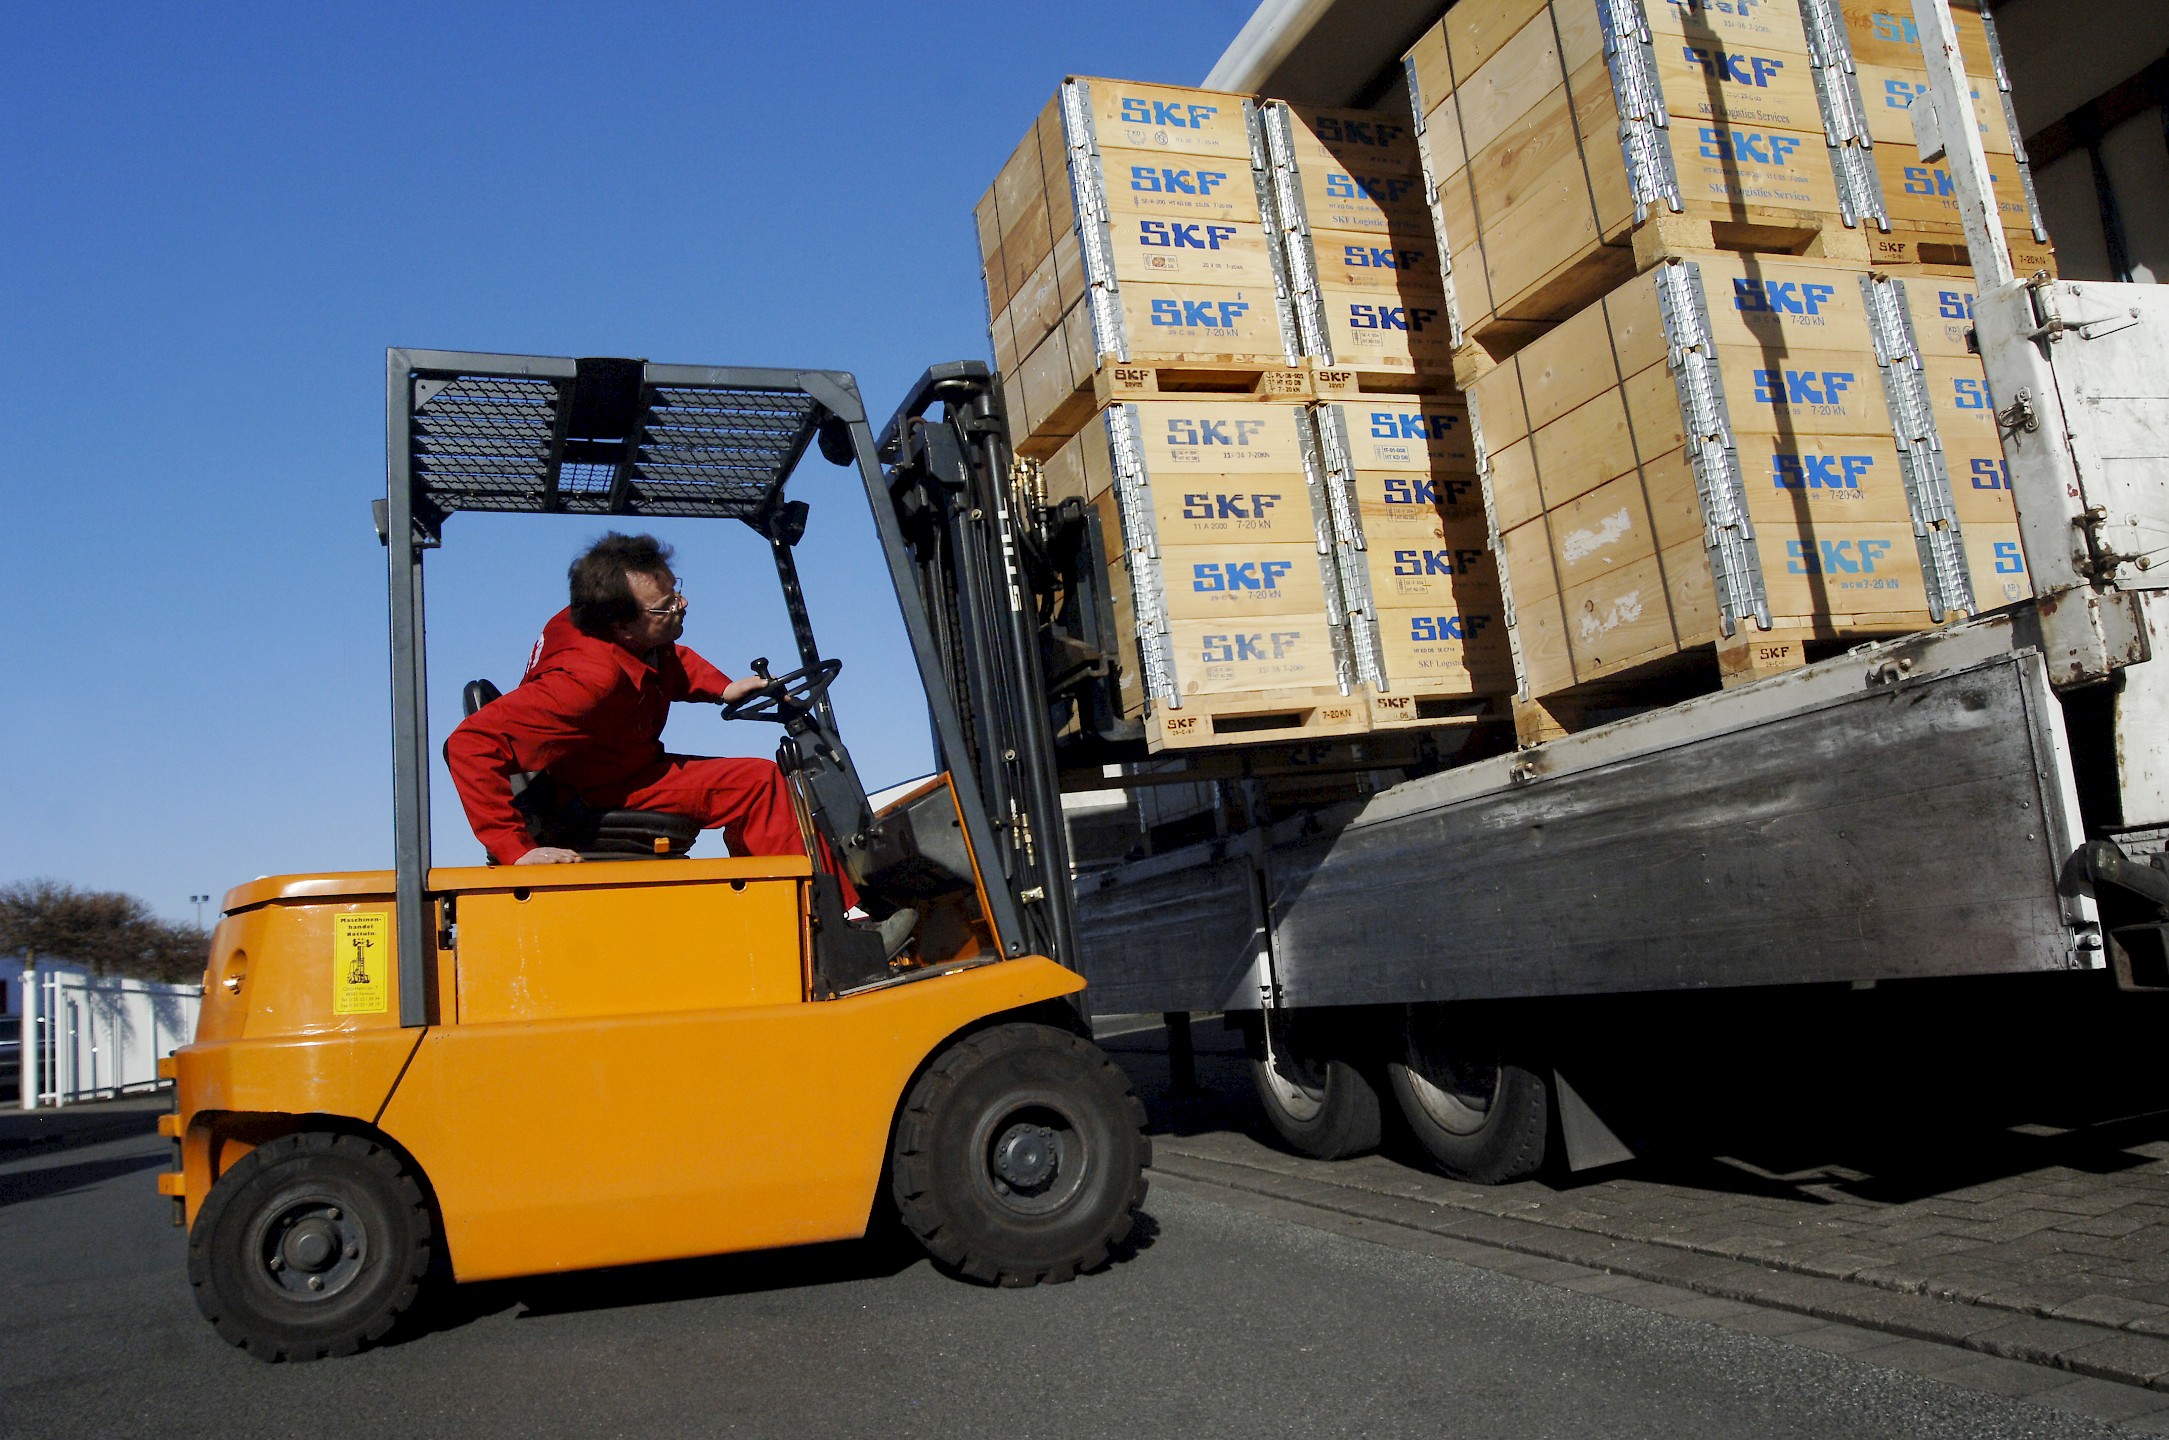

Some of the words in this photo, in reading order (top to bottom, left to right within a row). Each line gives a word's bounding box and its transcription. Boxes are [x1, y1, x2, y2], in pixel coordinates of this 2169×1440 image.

[1682, 46, 1784, 88] SKF
[1121, 97, 1218, 129] SKF
[1698, 102, 1716, 114] SKF
[1720, 104, 1756, 120] Logistics
[1756, 110, 1790, 124] Services
[1316, 117, 1403, 147] SKF
[1698, 127, 1800, 165] SKF
[1131, 166, 1227, 195] SKF
[1327, 174, 1414, 202] SKF
[1708, 183, 1729, 194] SKF
[1732, 184, 1772, 198] Logistics
[1773, 189, 1811, 201] Services
[1333, 216, 1352, 224] SKF
[1140, 220, 1237, 250] SKF
[1879, 241, 1906, 253] SKF
[1344, 246, 1424, 270] SKF
[1732, 278, 1835, 315] SKF
[1151, 299, 1249, 328] SKF
[1350, 304, 1438, 332] SKF
[1791, 315, 1811, 326] 7-20
[1812, 316, 1825, 326] kN
[1206, 328, 1225, 337] 7-20
[1115, 369, 1150, 380] SKF
[1320, 371, 1351, 382] SKF
[1753, 369, 1855, 405] SKF
[1811, 405, 1831, 415] 7-20
[1833, 405, 1846, 415] kN
[1167, 419, 1265, 446] SKF
[1370, 412, 1458, 439] SKF
[1772, 455, 1874, 489] SKF
[1384, 479, 1472, 505] SKF
[1829, 490, 1850, 500] 7-20
[1183, 493, 1281, 519] SKF
[1236, 520, 1257, 529] 7-20
[1259, 520, 1271, 529] kN
[998, 497, 1022, 612] STILL
[1394, 550, 1483, 576] SKF
[1786, 540, 1891, 574] SKF
[1193, 561, 1292, 592] SKF
[1864, 580, 1884, 589] 7-20
[1886, 579, 1899, 589] kN
[1248, 591, 1267, 600] 7-20
[1411, 615, 1492, 641] SKF
[1202, 632, 1301, 663] SKF
[1760, 646, 1789, 660] SKF
[1418, 660, 1434, 668] SKF
[1377, 697, 1410, 709] SKF
[1167, 718, 1197, 729] SKF
